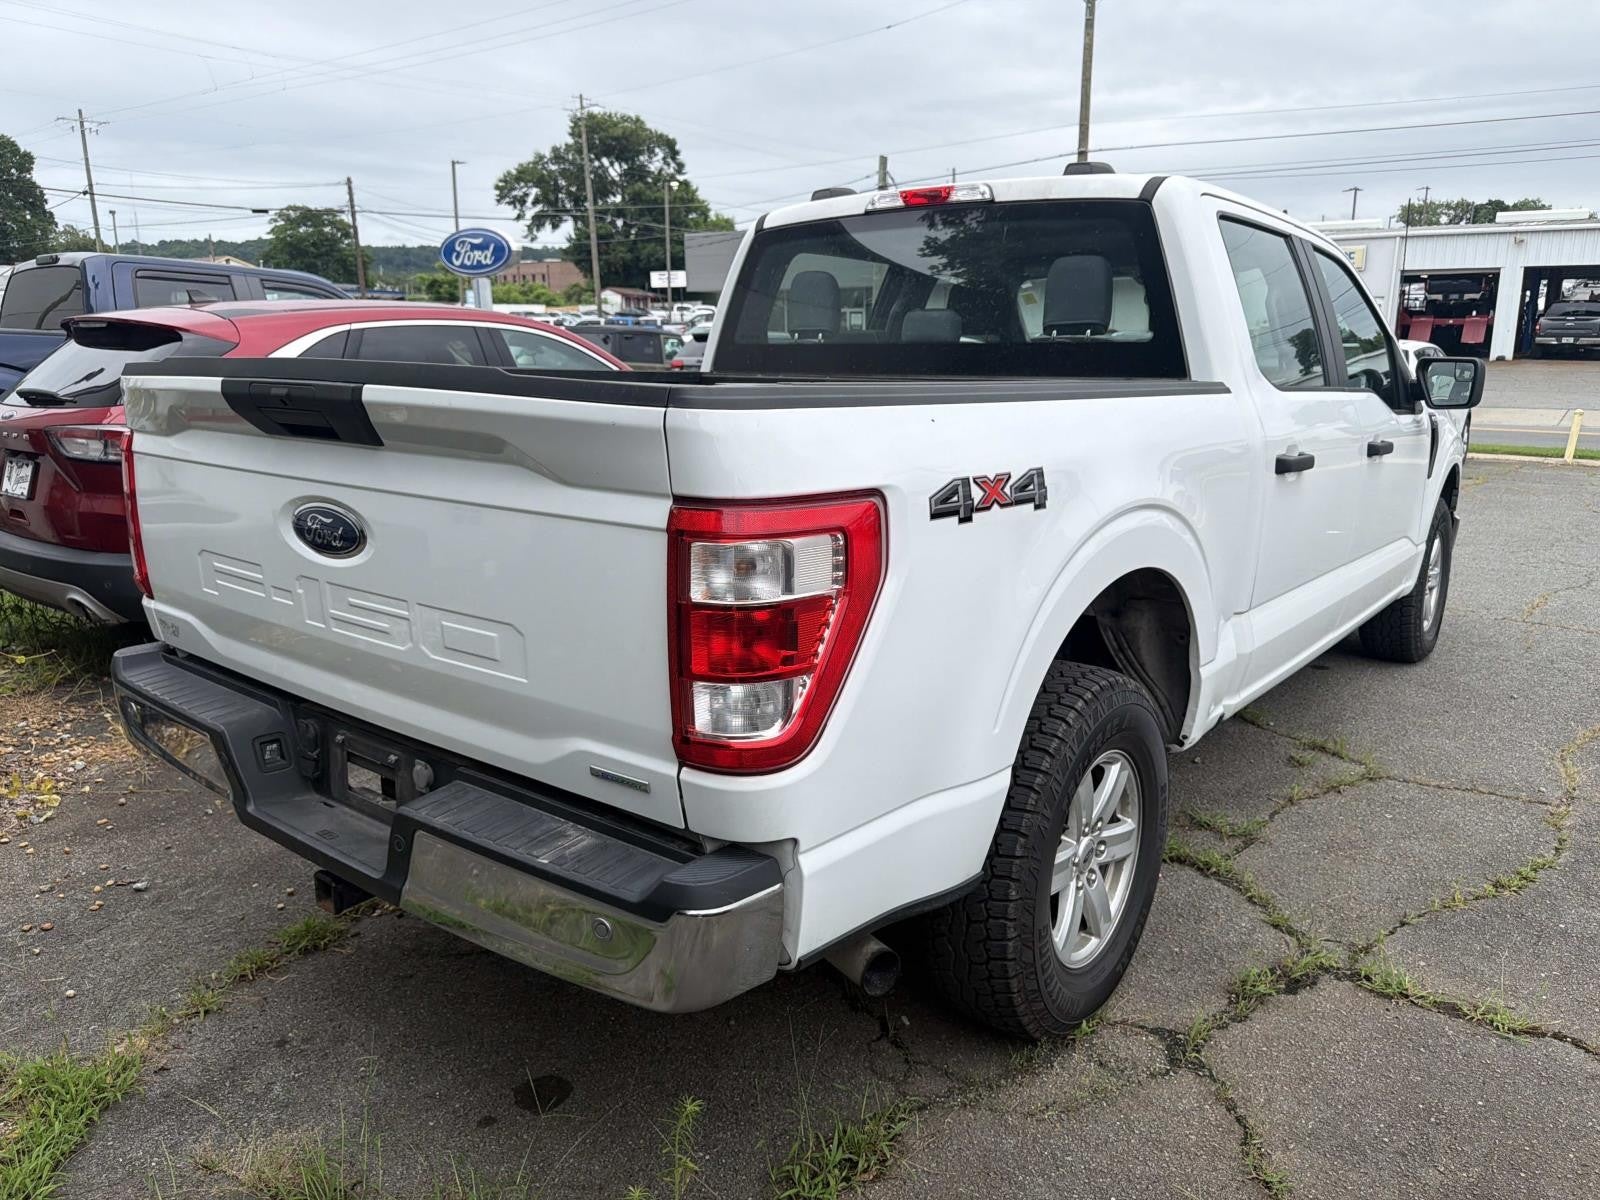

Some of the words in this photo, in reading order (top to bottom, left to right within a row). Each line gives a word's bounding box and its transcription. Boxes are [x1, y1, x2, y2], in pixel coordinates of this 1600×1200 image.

[452, 237, 495, 266] Ford
[304, 513, 344, 547] Ford
[198, 549, 528, 682] F-150
